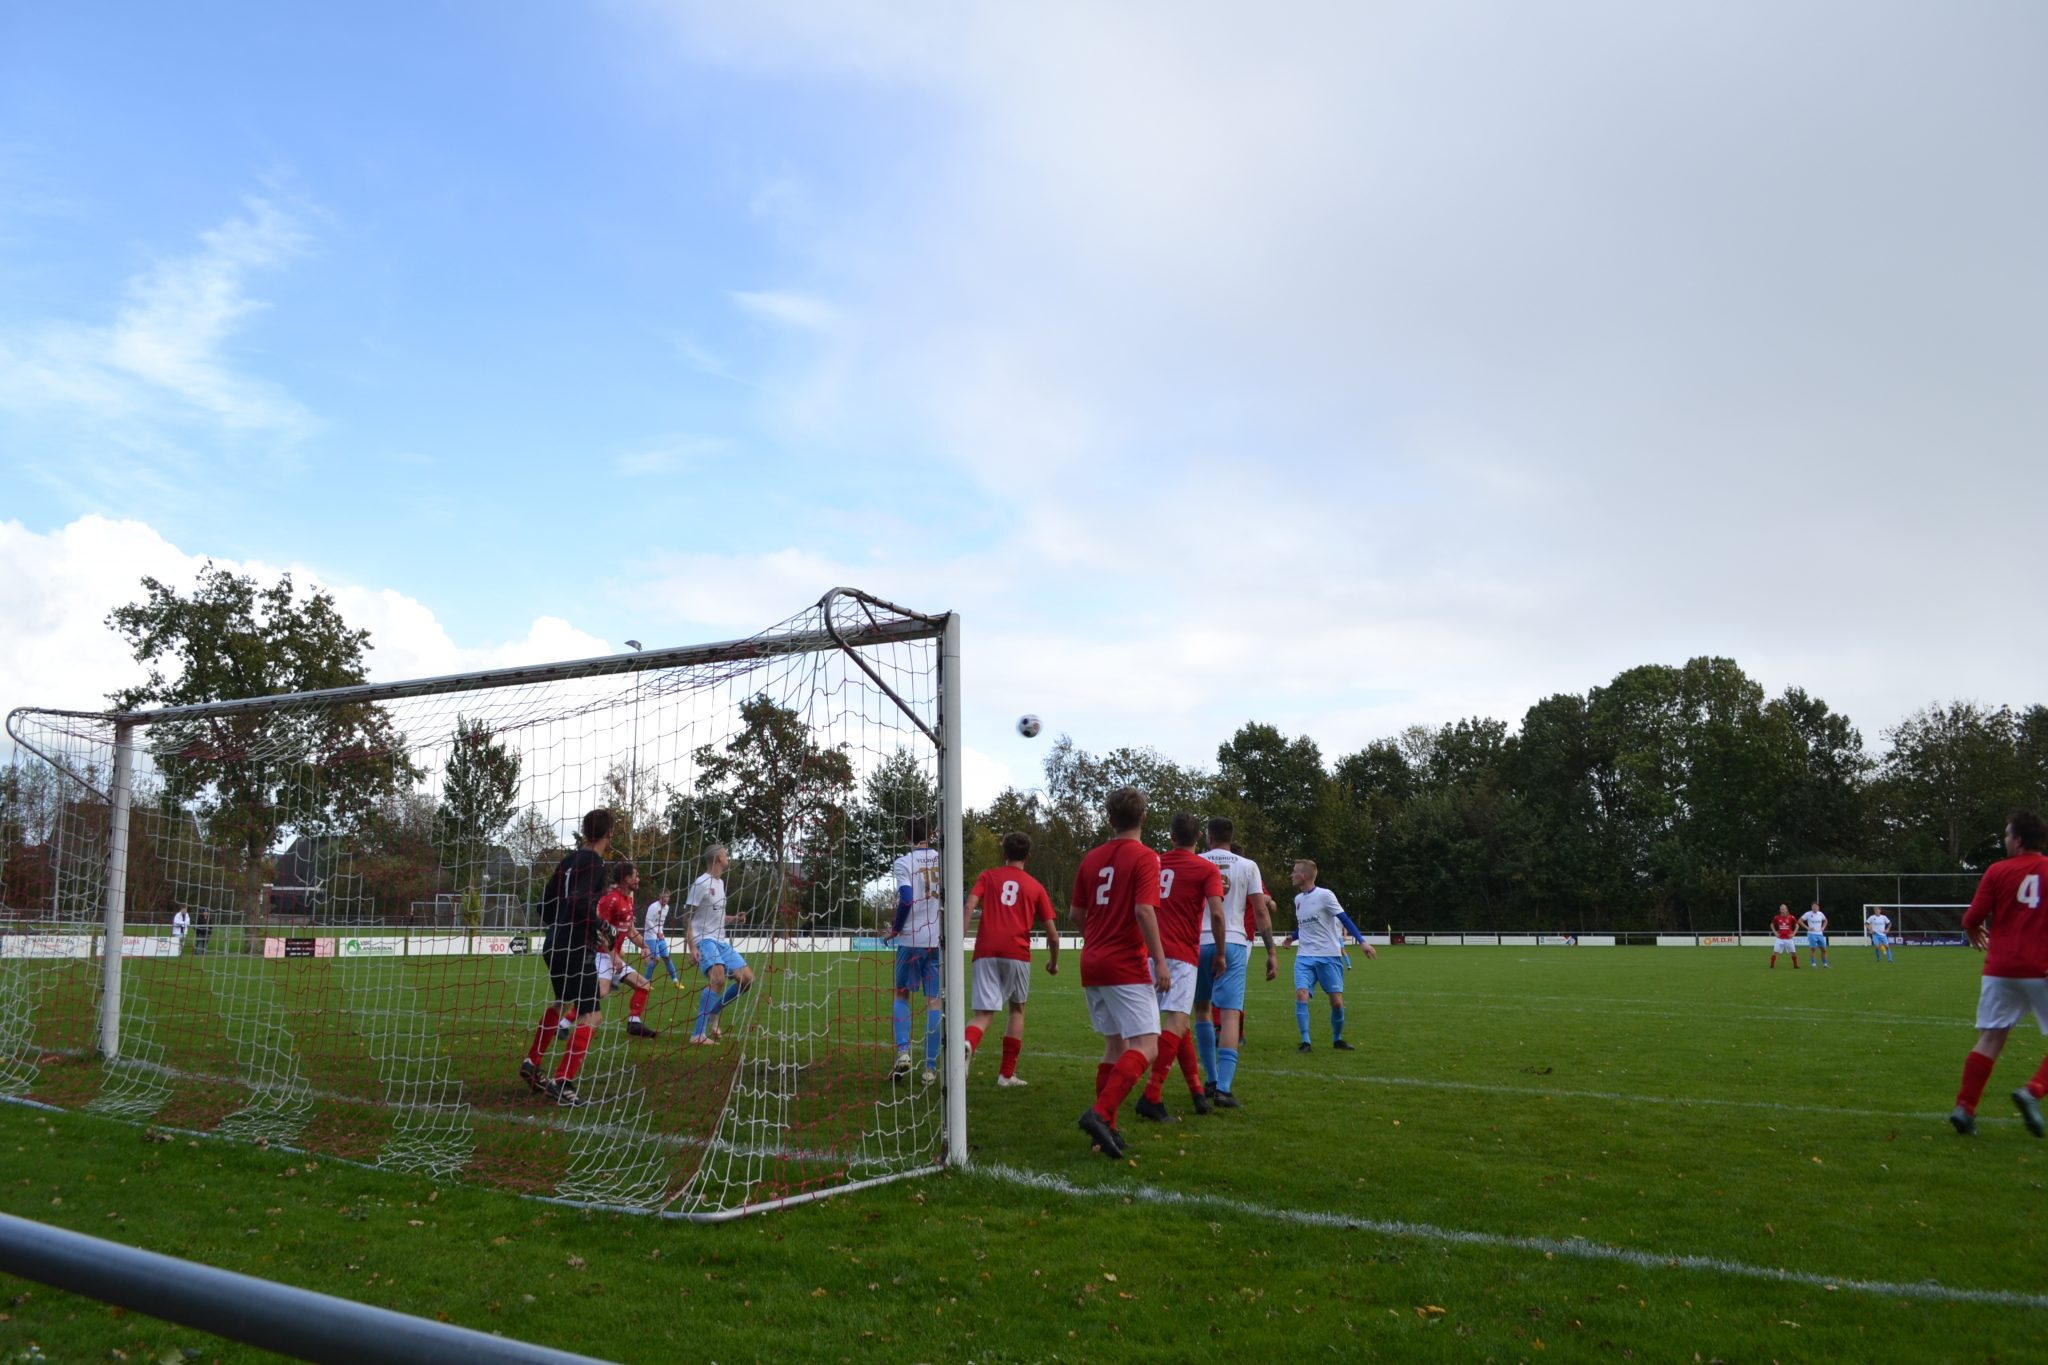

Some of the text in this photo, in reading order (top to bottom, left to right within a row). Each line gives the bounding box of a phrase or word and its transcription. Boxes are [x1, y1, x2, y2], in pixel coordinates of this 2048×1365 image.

[1001, 880, 1019, 906] 8
[1096, 866, 1114, 905] 2
[1159, 868, 1175, 899] 9
[2016, 874, 2040, 908] 4
[122, 938, 140, 946] Bank
[489, 943, 505, 952] 100
